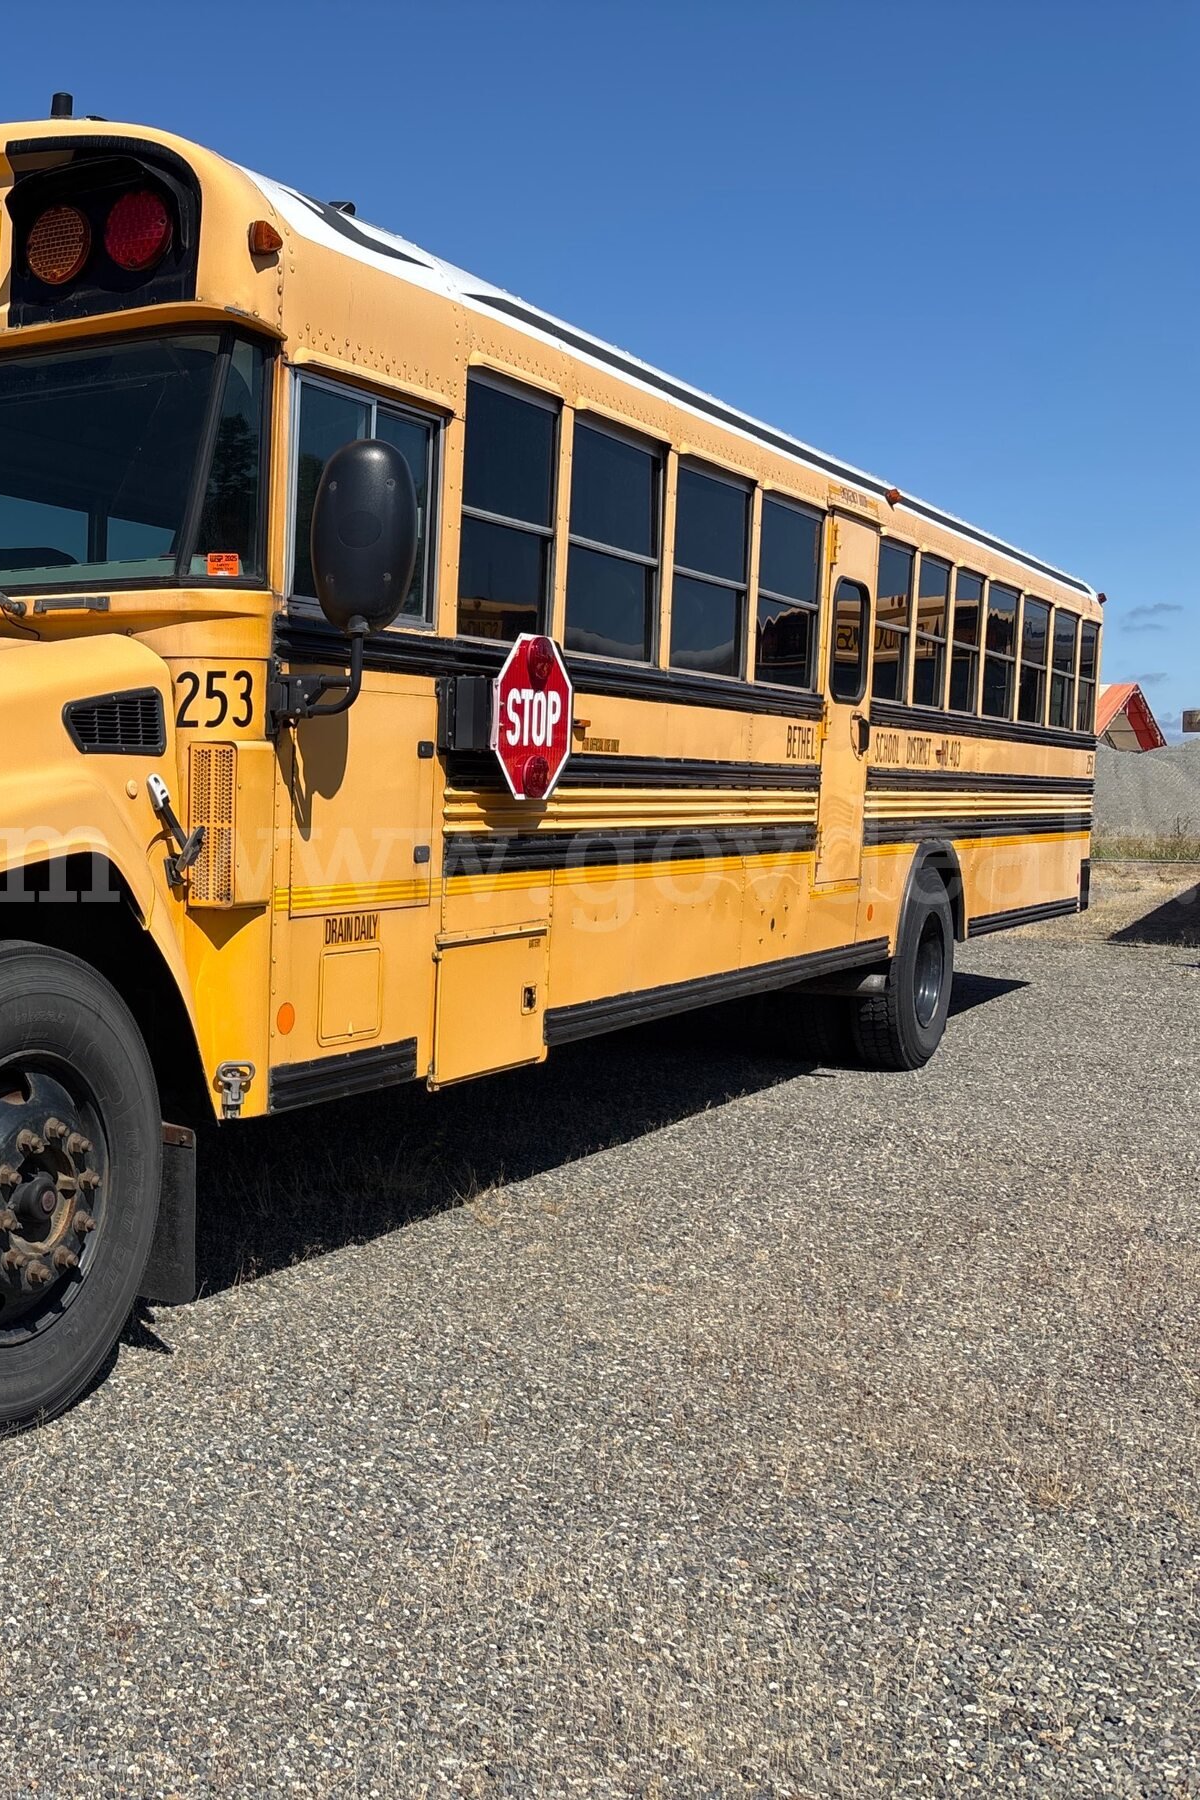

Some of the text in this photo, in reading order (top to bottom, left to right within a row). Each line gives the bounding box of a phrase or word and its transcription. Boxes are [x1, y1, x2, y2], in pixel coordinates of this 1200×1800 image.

[176, 670, 253, 728] 253
[506, 687, 561, 747] STOP
[786, 725, 816, 760] BETHEL
[875, 733, 900, 763] SCHOOL
[906, 736, 932, 765] DISTRICT
[325, 914, 379, 945] DRAIN DAILY
